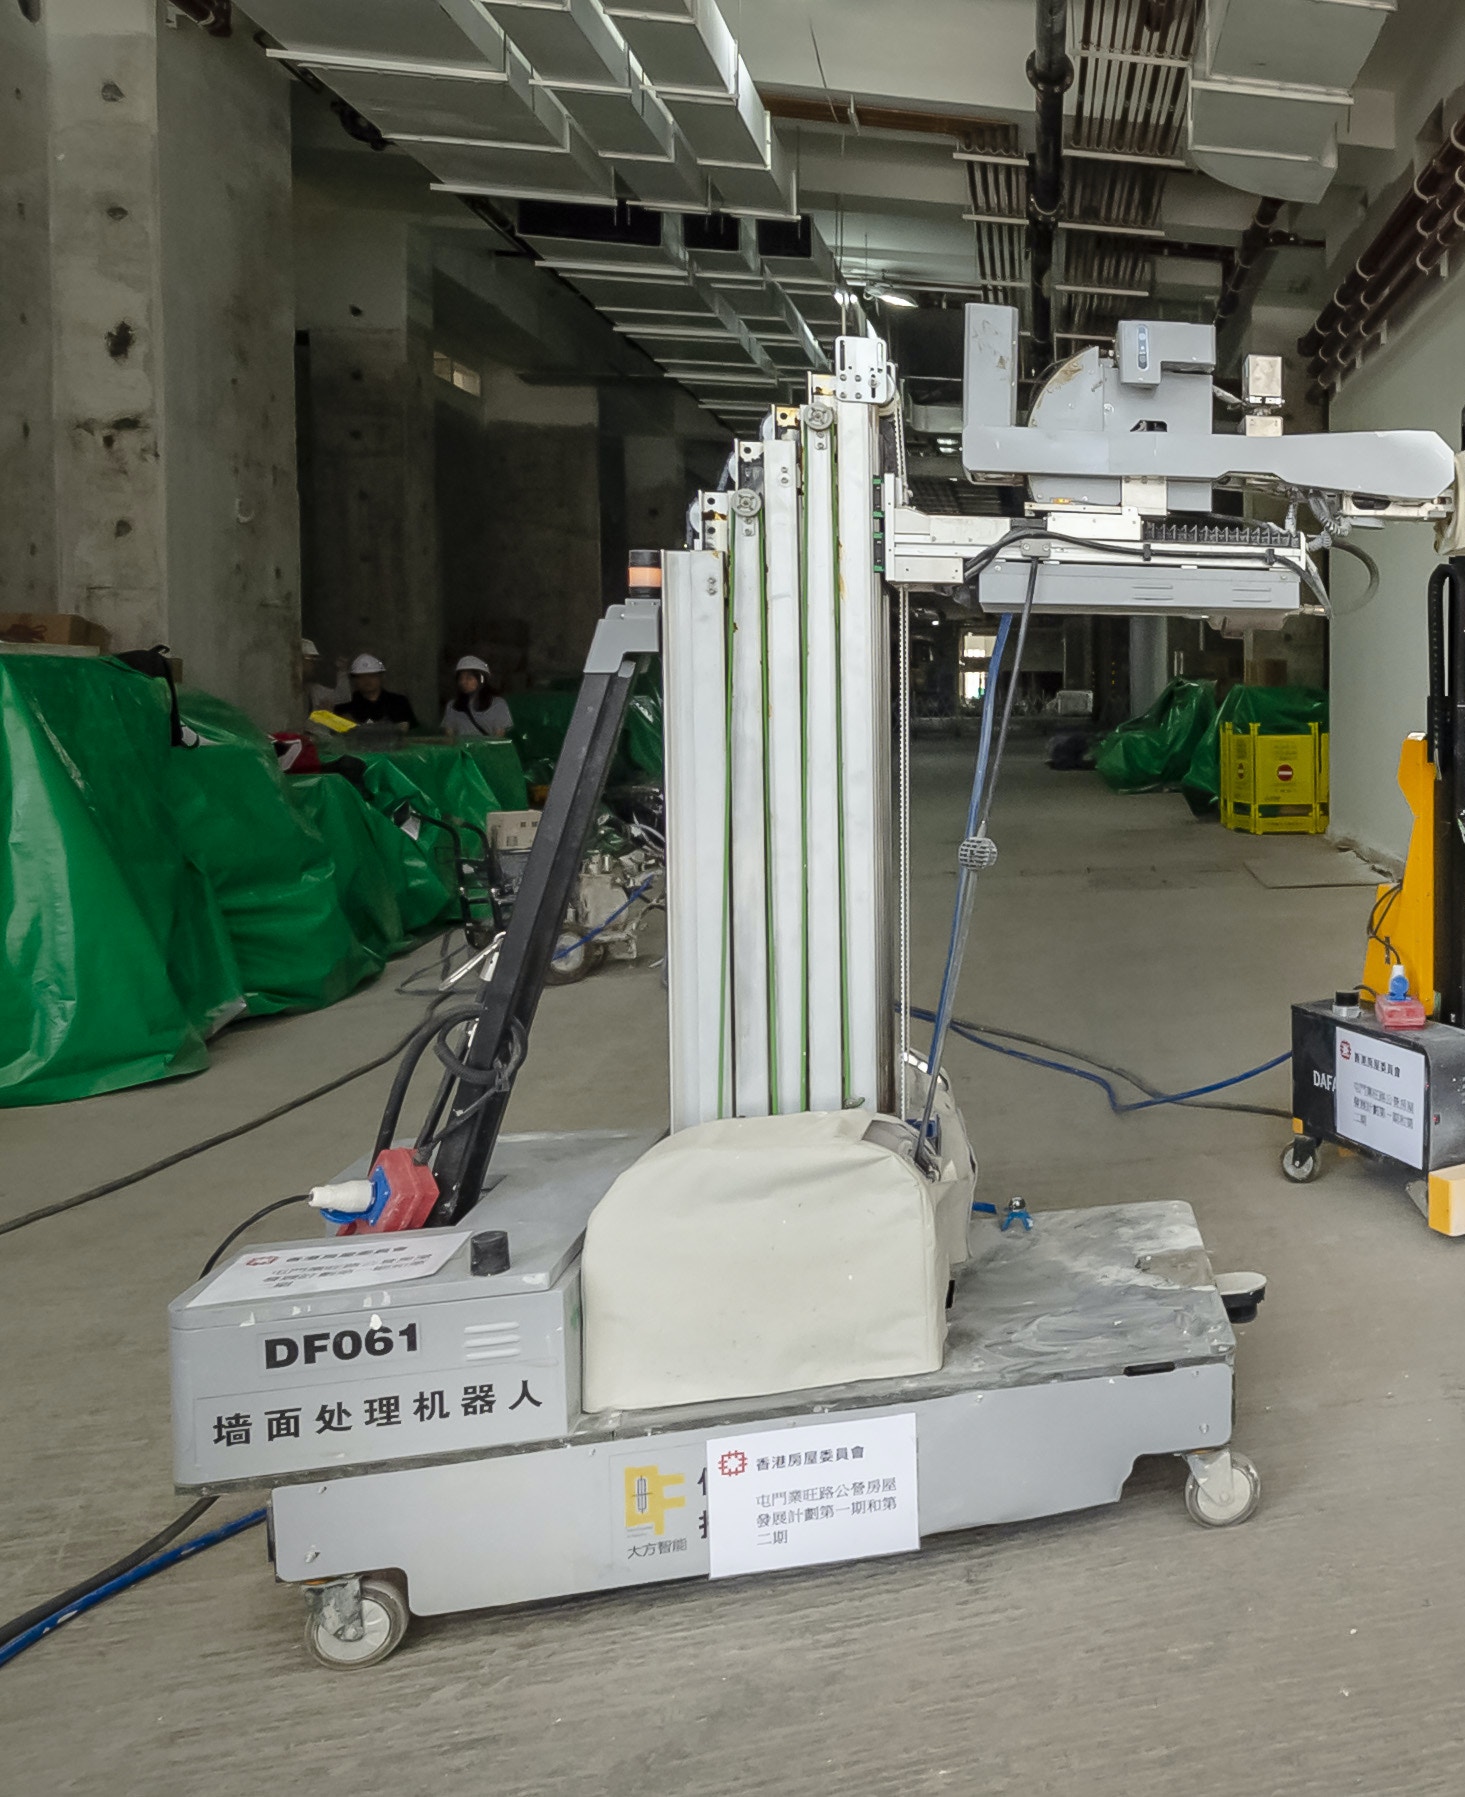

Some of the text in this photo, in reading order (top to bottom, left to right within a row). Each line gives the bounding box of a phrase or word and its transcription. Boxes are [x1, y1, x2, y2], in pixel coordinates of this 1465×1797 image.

[264, 1323, 418, 1370] DF061
[213, 1379, 543, 1447] 墙面处理机器人
[756, 1445, 865, 1471] 香港房屋委員會
[755, 1496, 897, 1528] 發展計劃第一期和第
[627, 1538, 688, 1560] 大方智能
[756, 1529, 788, 1546] 二期
